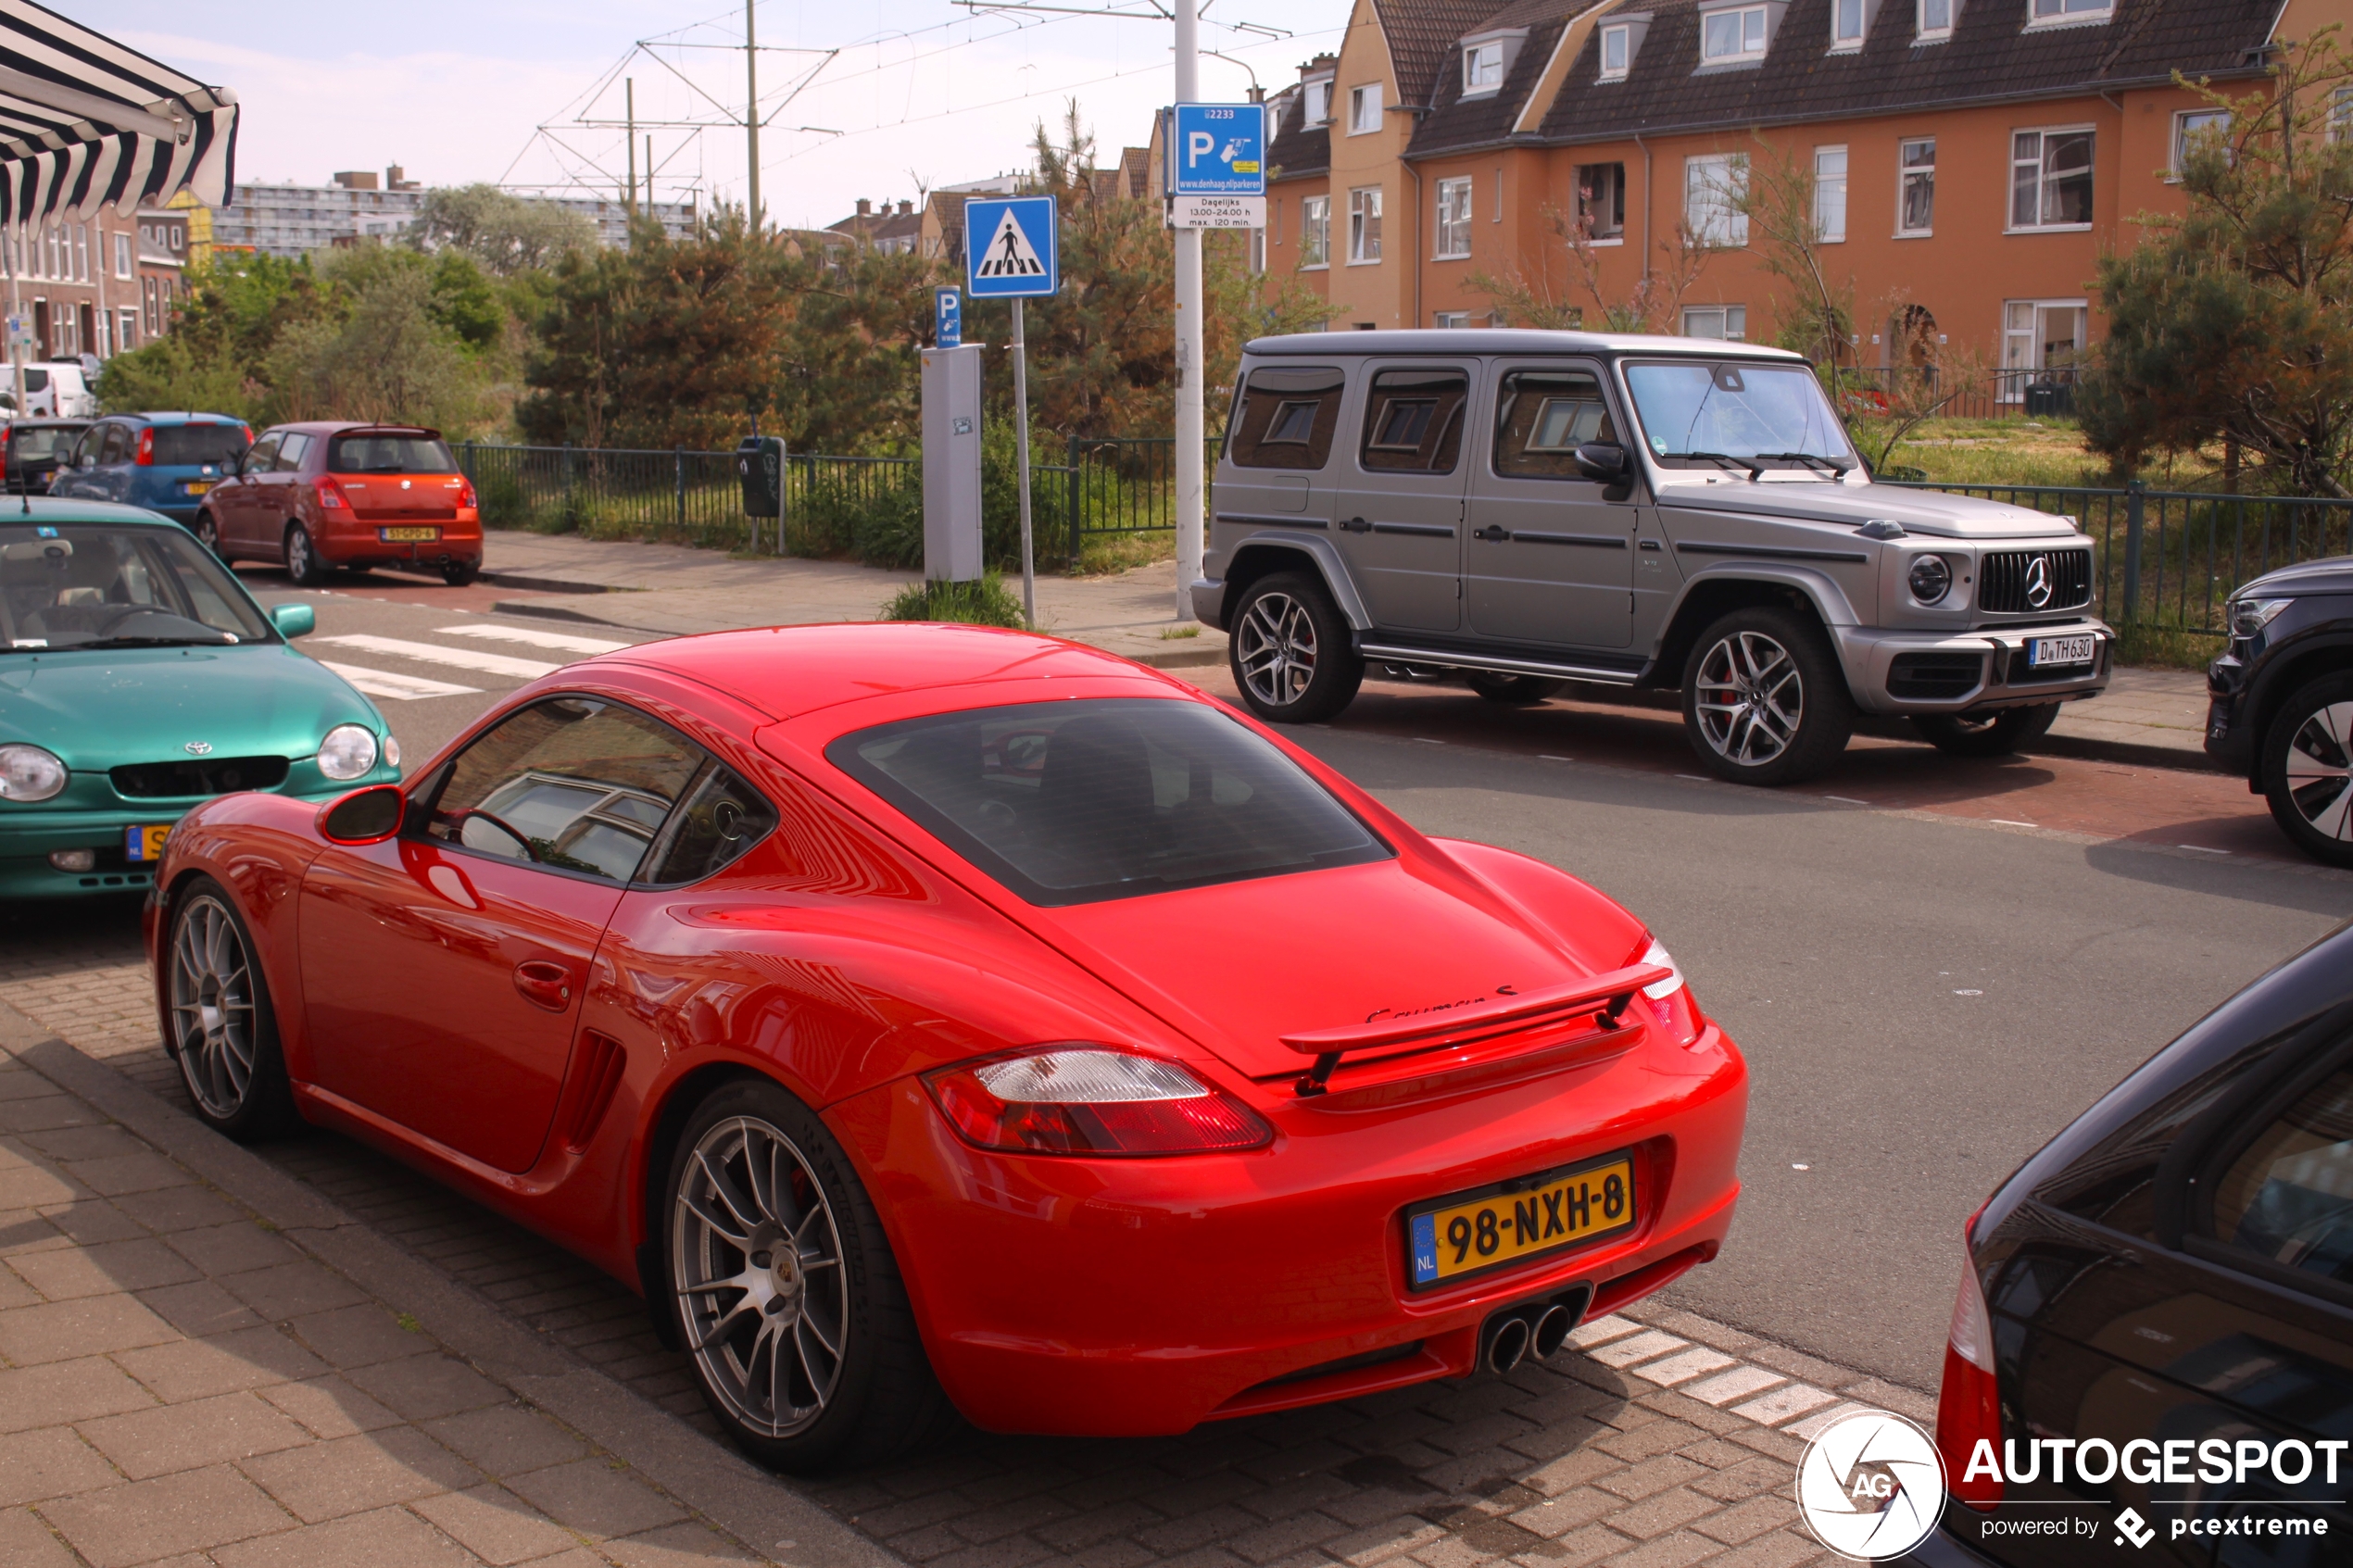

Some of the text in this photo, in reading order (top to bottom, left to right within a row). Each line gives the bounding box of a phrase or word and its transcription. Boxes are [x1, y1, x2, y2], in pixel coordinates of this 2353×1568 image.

[1210, 109, 1234, 119] 2233
[1189, 132, 1214, 168] P
[1179, 179, 1261, 191] www.denhaag.nl/parkeren
[1202, 198, 1240, 208] Dagelijks
[940, 294, 958, 319] P
[2040, 638, 2090, 660] D TH 630
[130, 847, 141, 856] NL
[151, 831, 166, 854] S
[1448, 1173, 1625, 1264] 98-NXH-8
[1417, 1256, 1434, 1272] NL
